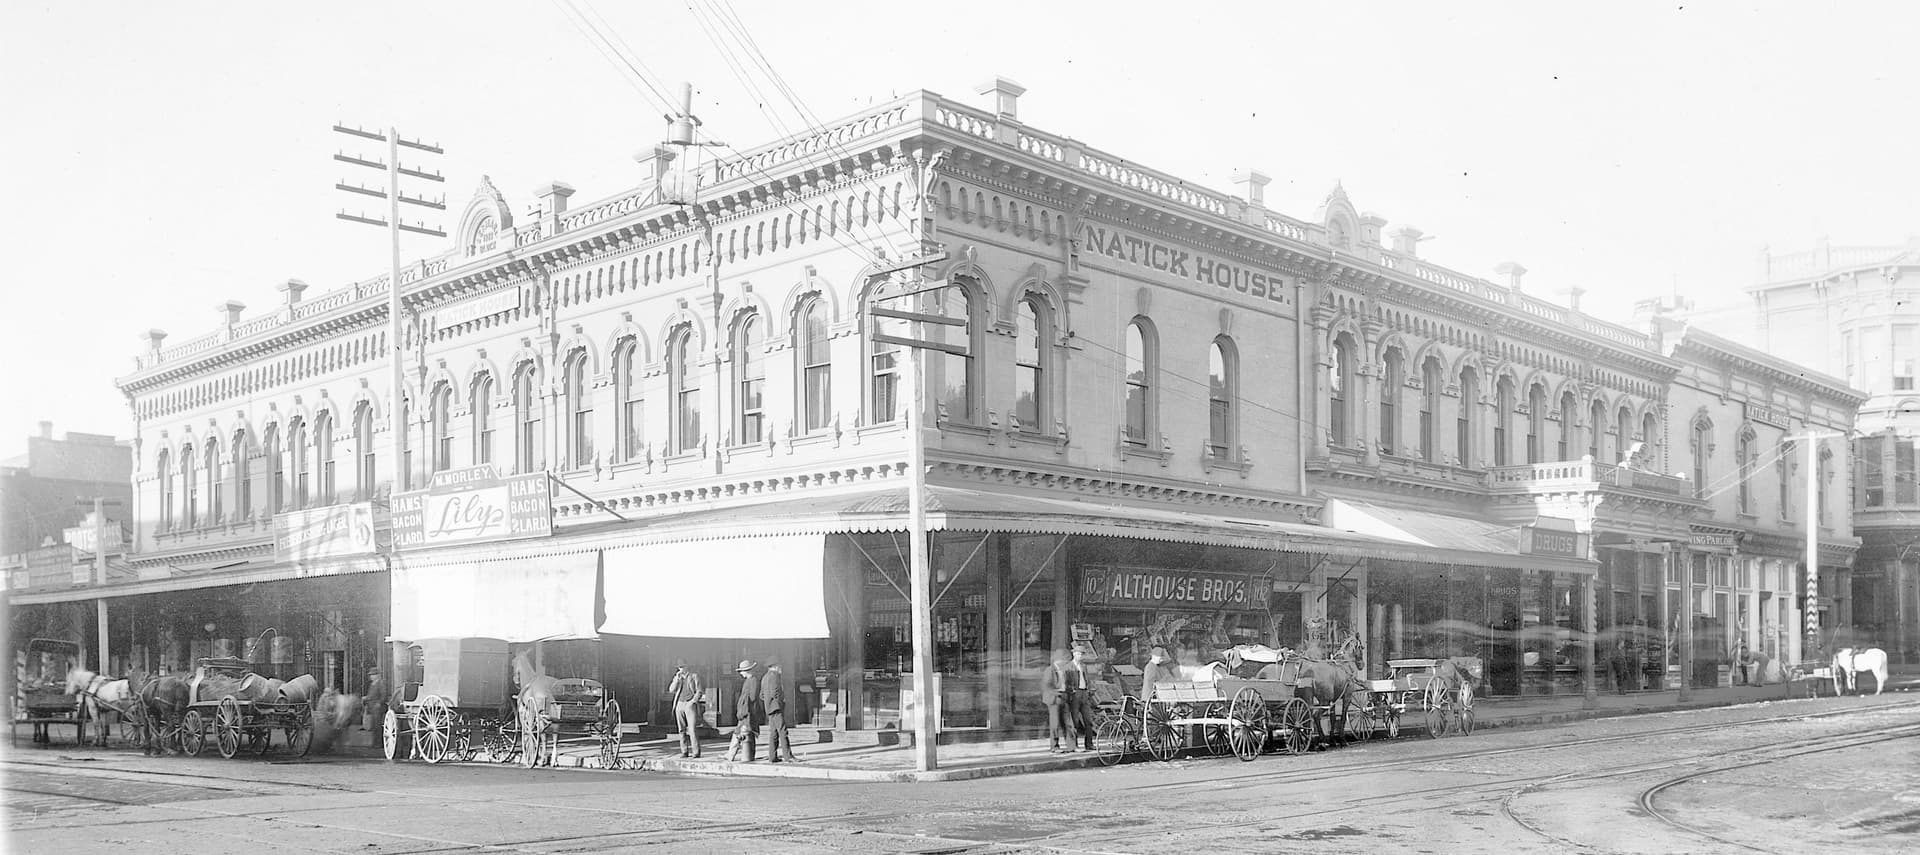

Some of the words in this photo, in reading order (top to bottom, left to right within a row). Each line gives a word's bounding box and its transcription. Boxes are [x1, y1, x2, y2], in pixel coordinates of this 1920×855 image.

[1086, 225, 1189, 277] NATICK
[1196, 256, 1290, 305] HOUSE.
[511, 497, 546, 514] BACON
[392, 513, 422, 529] BACON
[429, 494, 504, 537] Lily
[1535, 533, 1573, 552] DRUGS
[1706, 535, 1732, 545] PARLO
[1112, 573, 1197, 601] ALTHOUSE
[1202, 579, 1248, 603] BROS.
